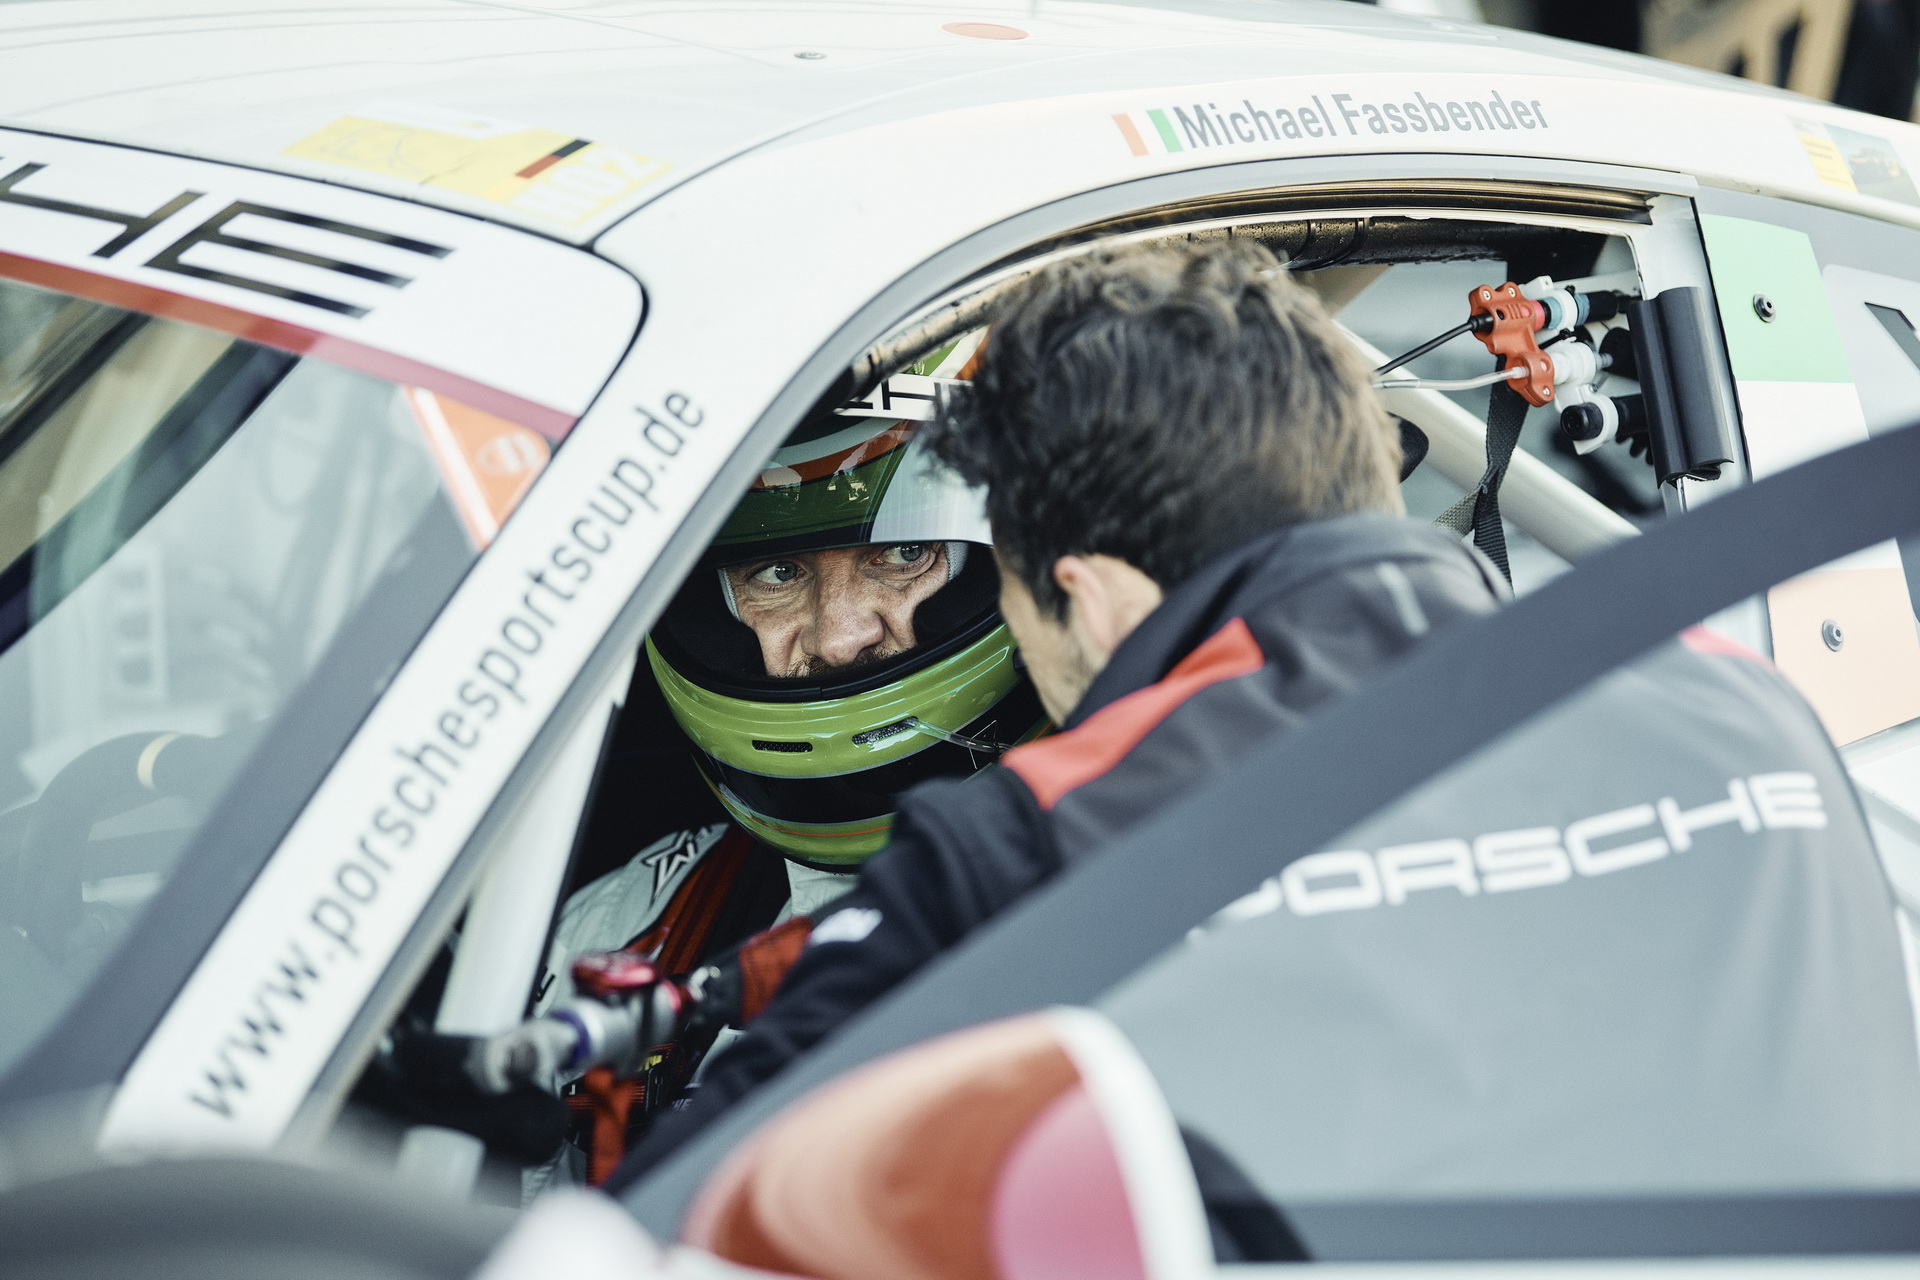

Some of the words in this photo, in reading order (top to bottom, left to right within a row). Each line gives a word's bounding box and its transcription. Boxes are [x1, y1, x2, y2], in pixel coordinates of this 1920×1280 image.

[1173, 95, 1336, 149] Michael
[1331, 90, 1549, 136] Fassbender
[0, 157, 456, 320] HE
[187, 388, 706, 1120] www.porschesportscup.de
